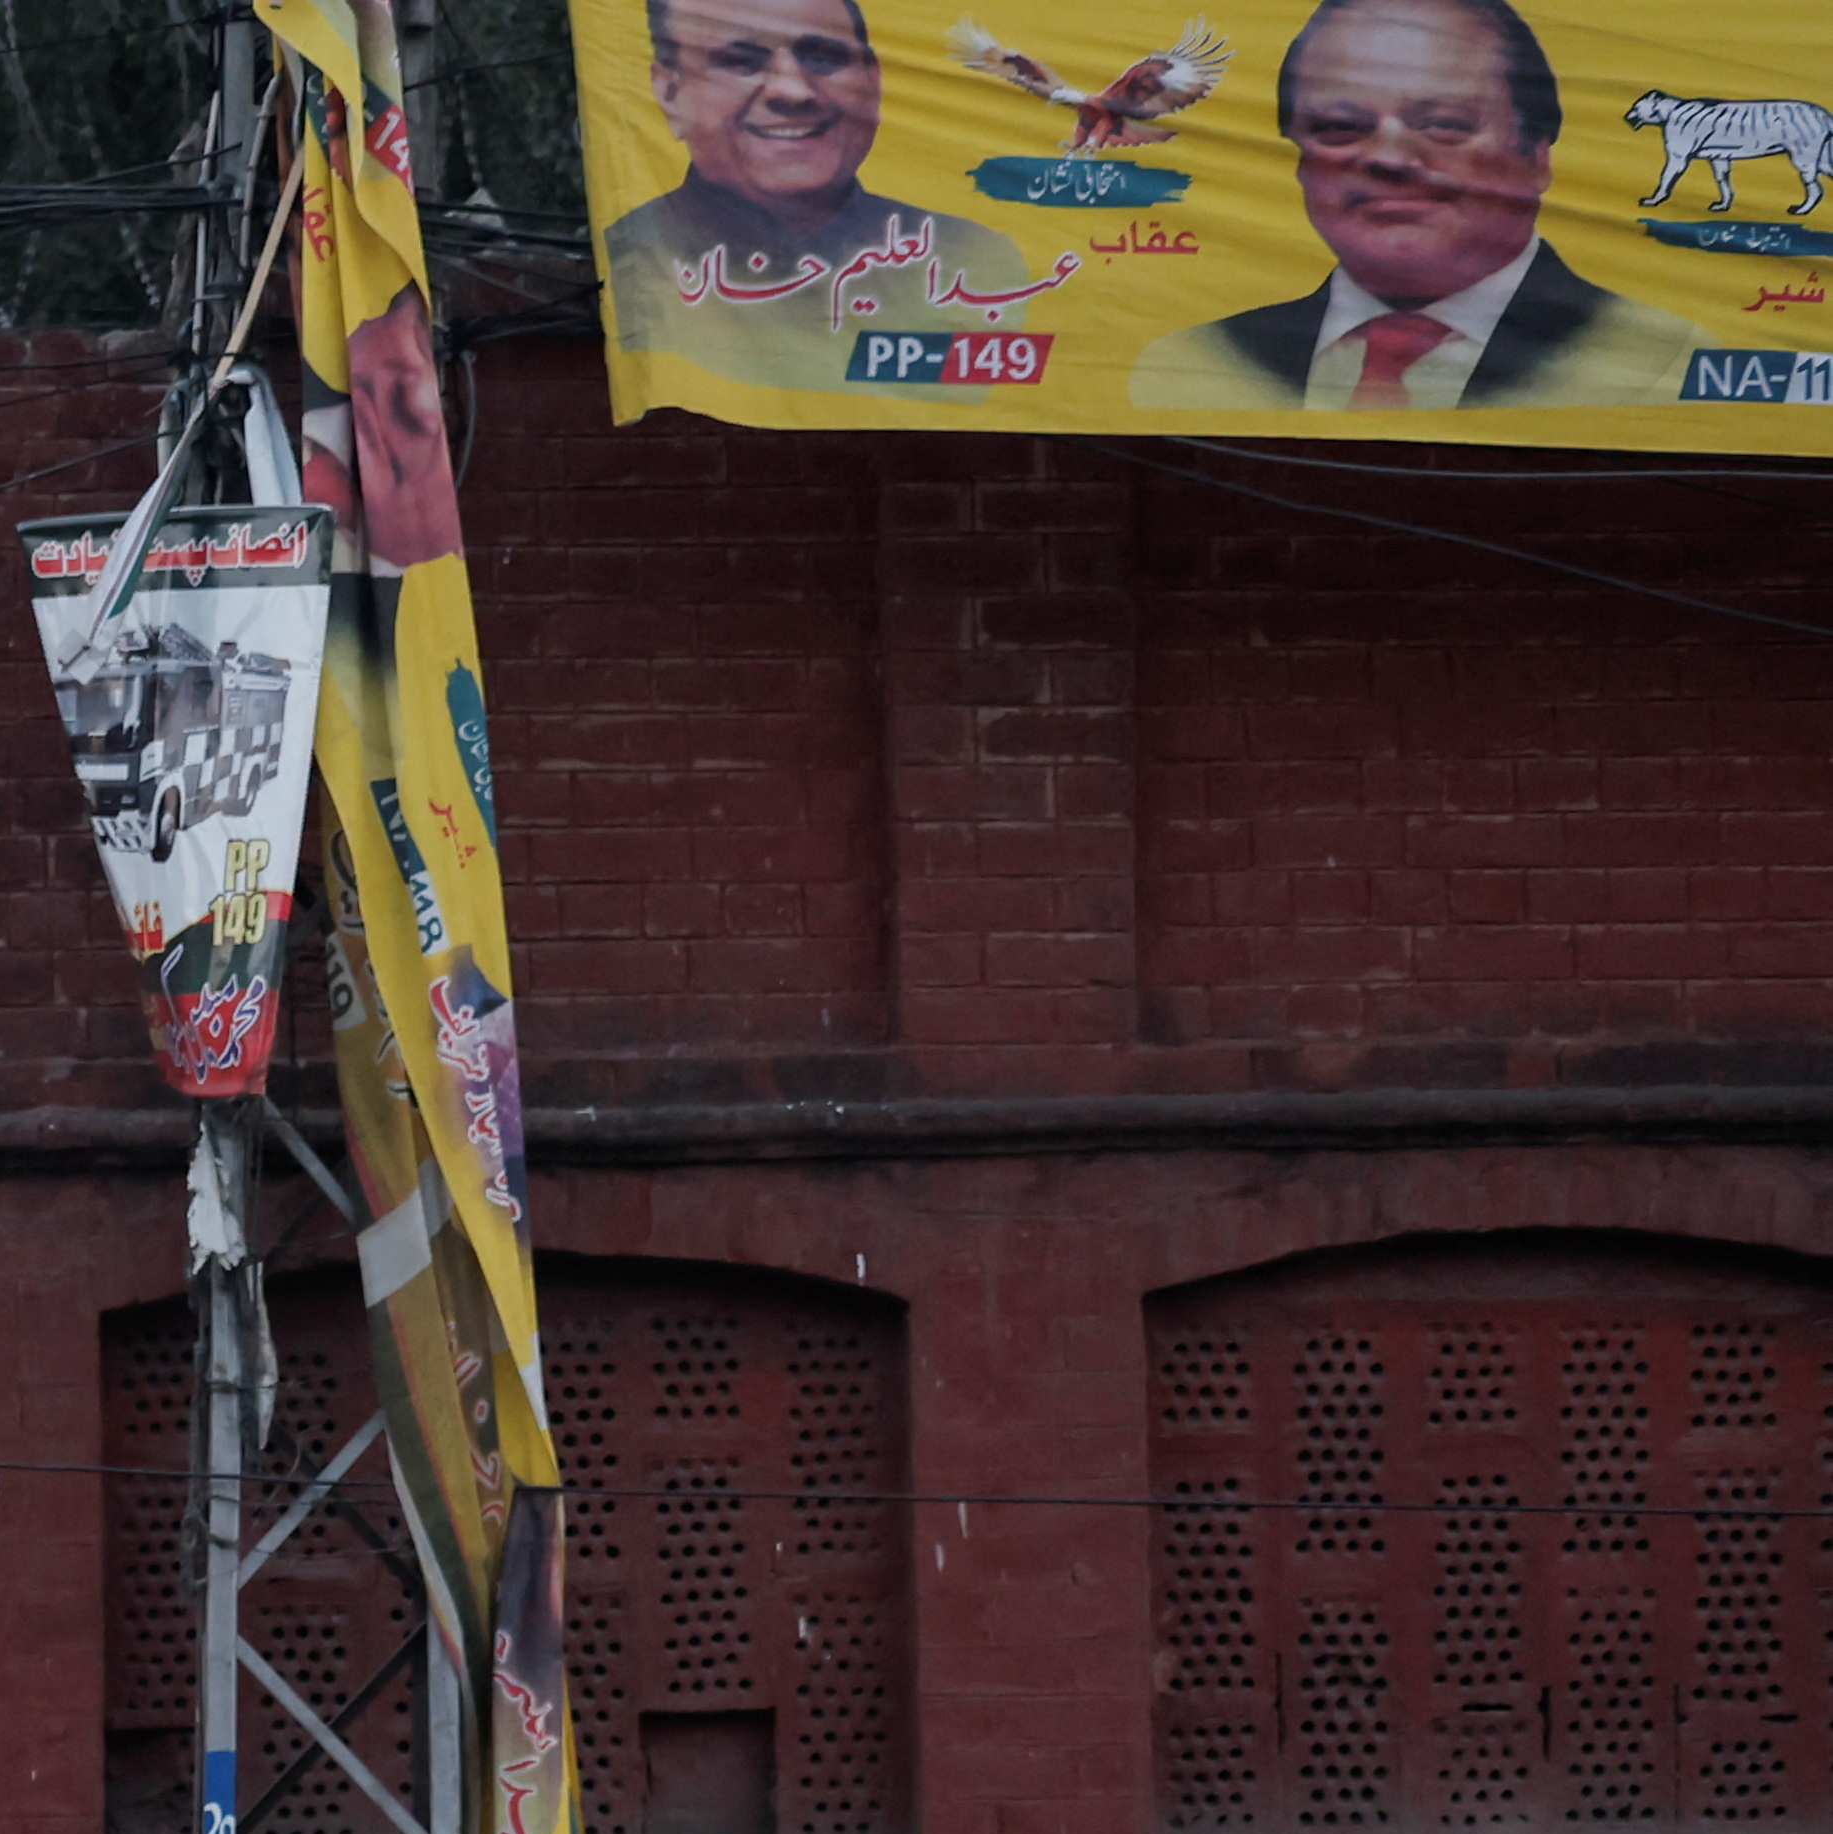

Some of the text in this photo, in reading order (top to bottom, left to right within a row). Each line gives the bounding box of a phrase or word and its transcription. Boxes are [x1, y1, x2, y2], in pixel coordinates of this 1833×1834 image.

[1089, 221, 1200, 265] عقاب
[673, 243, 830, 306] خان
[1742, 270, 1825, 312] شیر
[866, 336, 1036, 379] PP-149
[1698, 355, 1833, 400] NA-11
[224, 838, 270, 892] PP
[209, 892, 268, 947] 149
